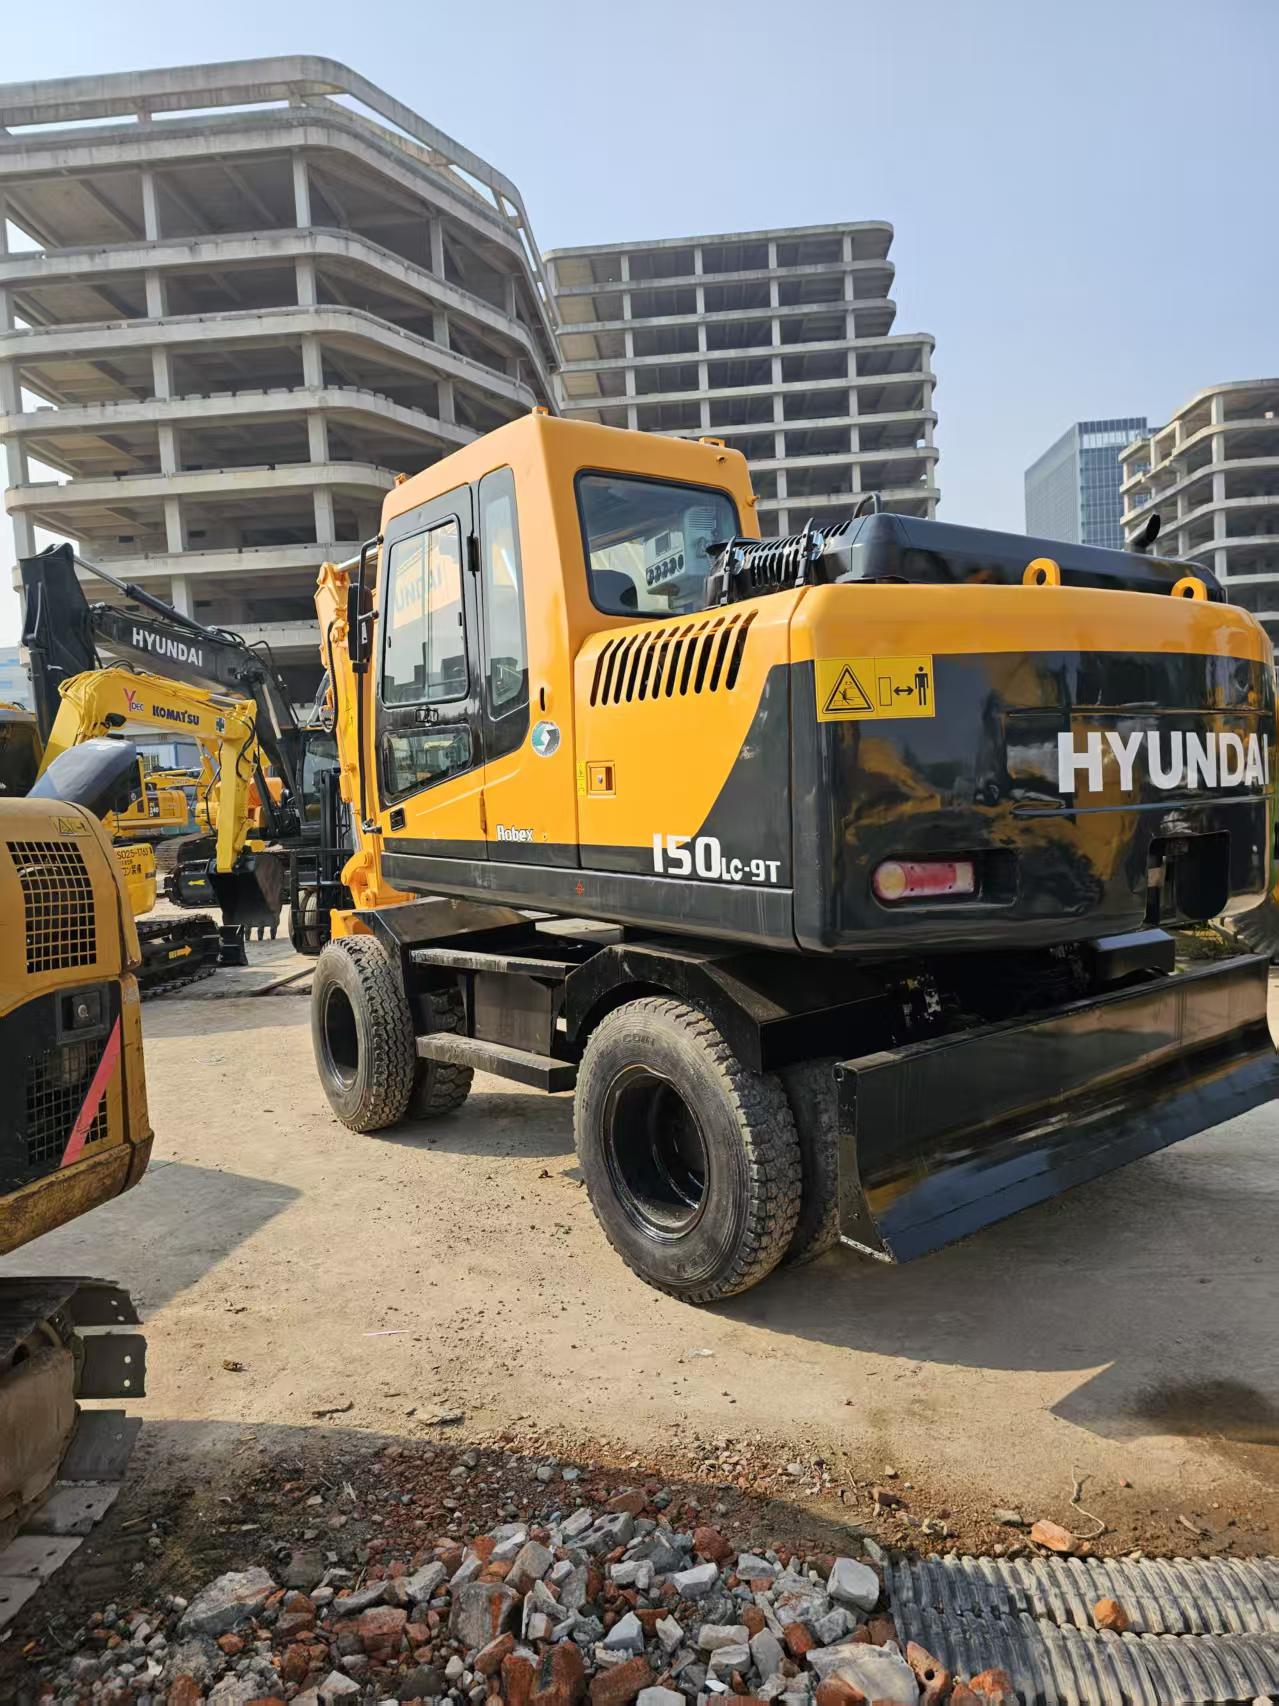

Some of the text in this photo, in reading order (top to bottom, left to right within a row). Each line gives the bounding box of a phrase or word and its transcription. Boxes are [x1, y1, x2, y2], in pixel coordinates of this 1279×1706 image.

[132, 627, 203, 667] HYUNDAI
[152, 704, 200, 726] KOMATSU
[1057, 731, 1270, 793] HYUNDAI
[496, 824, 534, 842] Robex
